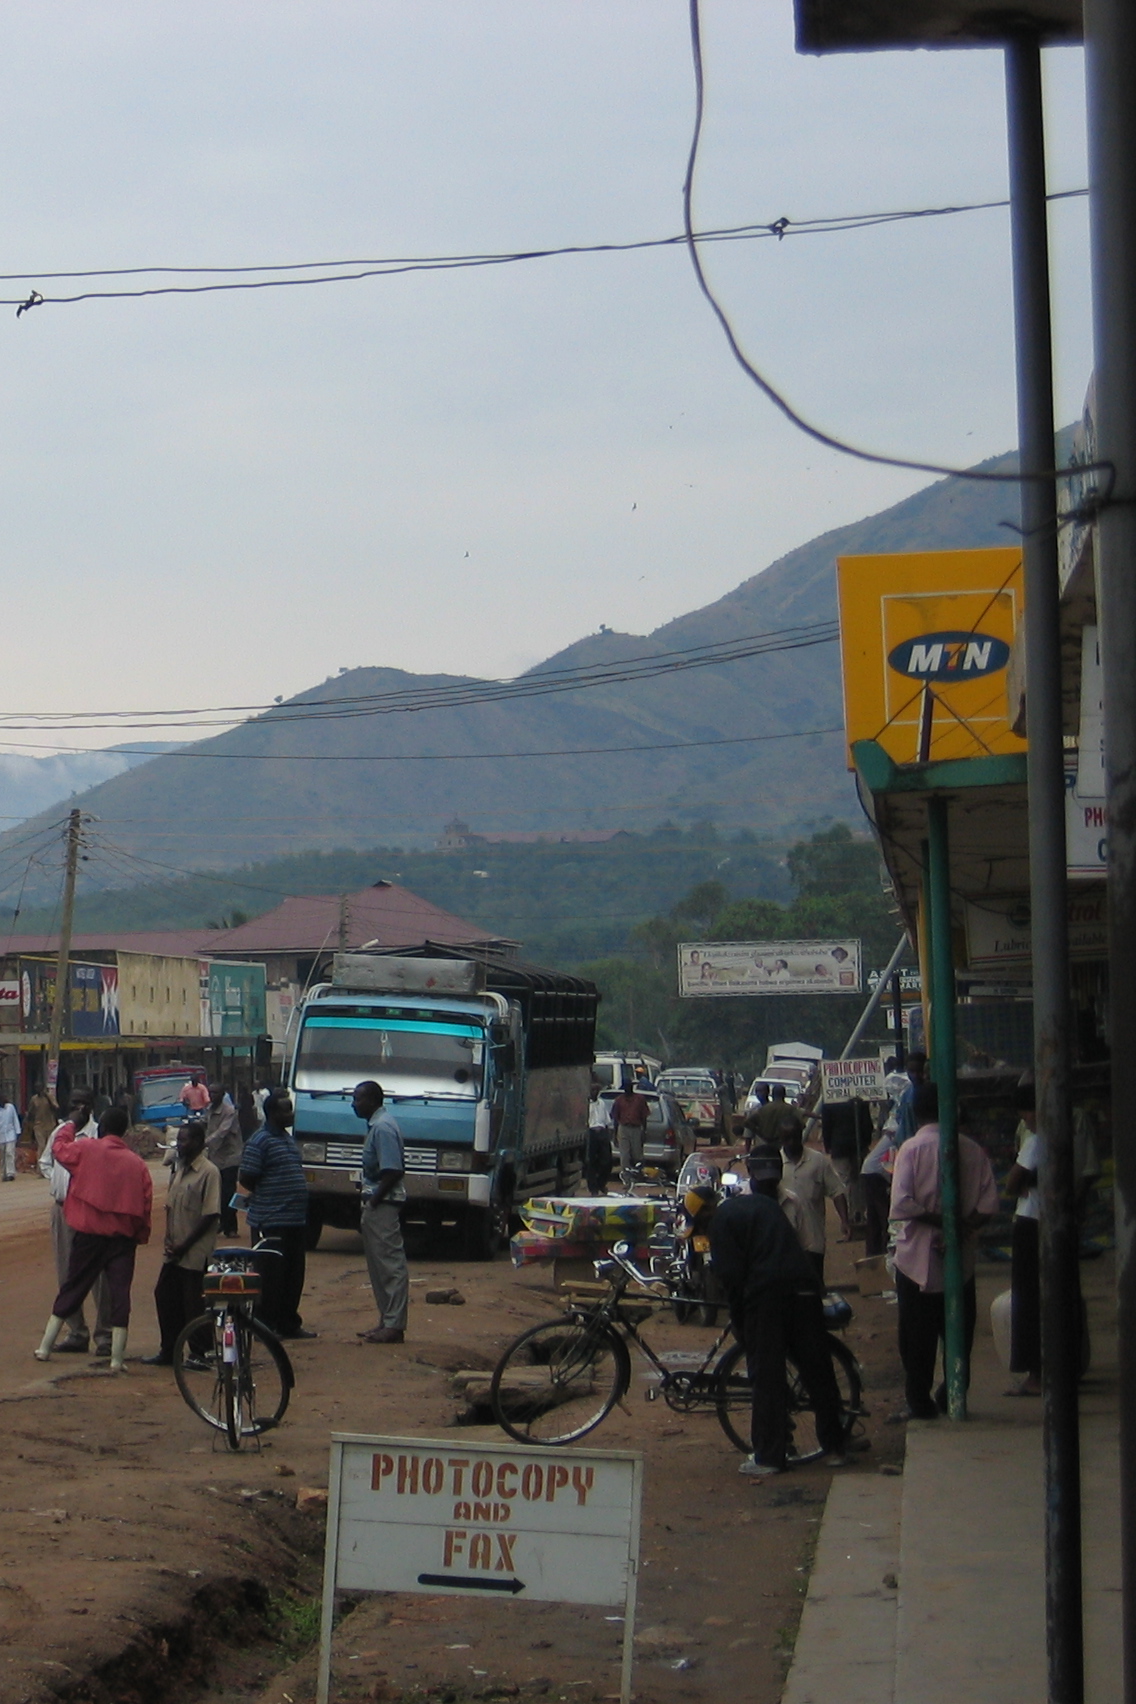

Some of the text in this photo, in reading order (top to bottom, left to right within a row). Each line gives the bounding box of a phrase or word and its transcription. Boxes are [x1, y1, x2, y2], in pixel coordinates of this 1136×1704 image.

[907, 641, 992, 672] MTN
[1084, 807, 1107, 828] PH
[828, 1075, 876, 1088] COMPUTER
[371, 1453, 595, 1506] PHOTOCOPY
[453, 1502, 511, 1523] AND
[443, 1530, 518, 1571] FAX
